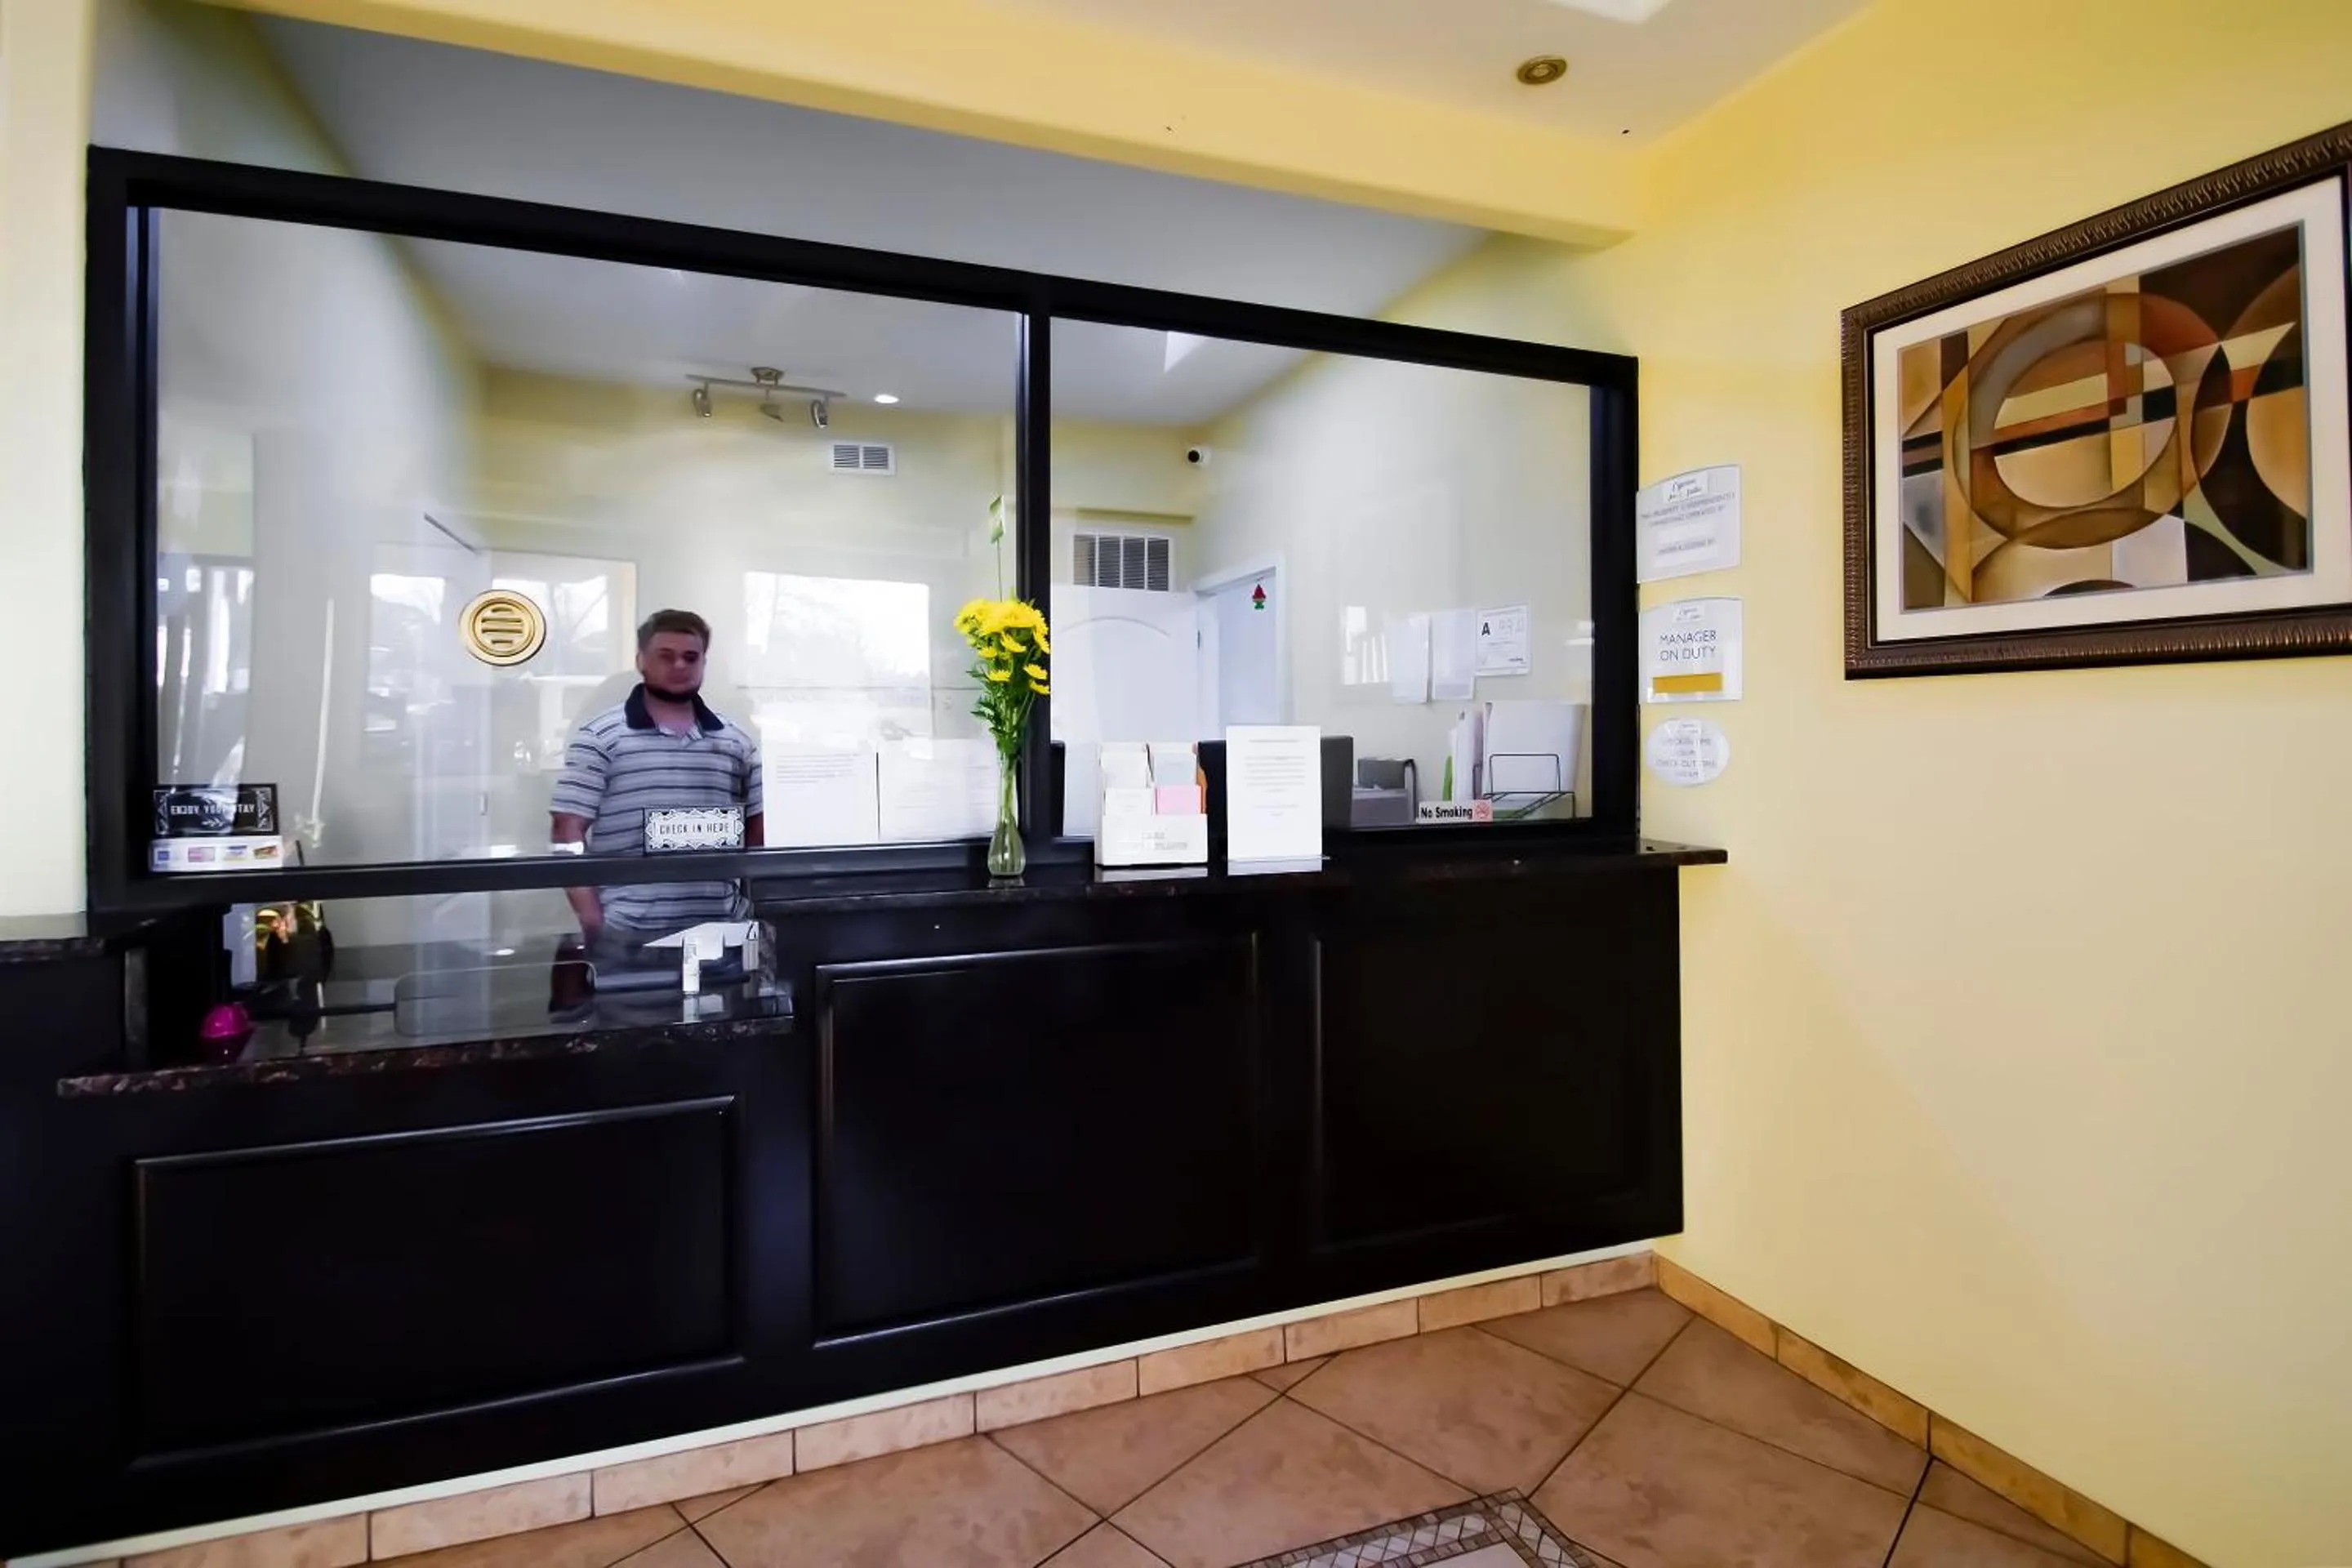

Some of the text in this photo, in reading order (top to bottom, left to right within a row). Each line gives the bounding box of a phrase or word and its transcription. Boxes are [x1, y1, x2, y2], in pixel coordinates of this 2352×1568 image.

[1481, 621, 1490, 635] A
[1659, 630, 1716, 645] MANAGER
[1659, 645, 1716, 662] ON DUTY
[170, 805, 200, 815] ENJOY
[1421, 805, 1473, 820] No Smoking
[659, 823, 688, 835] CHECK
[693, 823, 702, 833] IN
